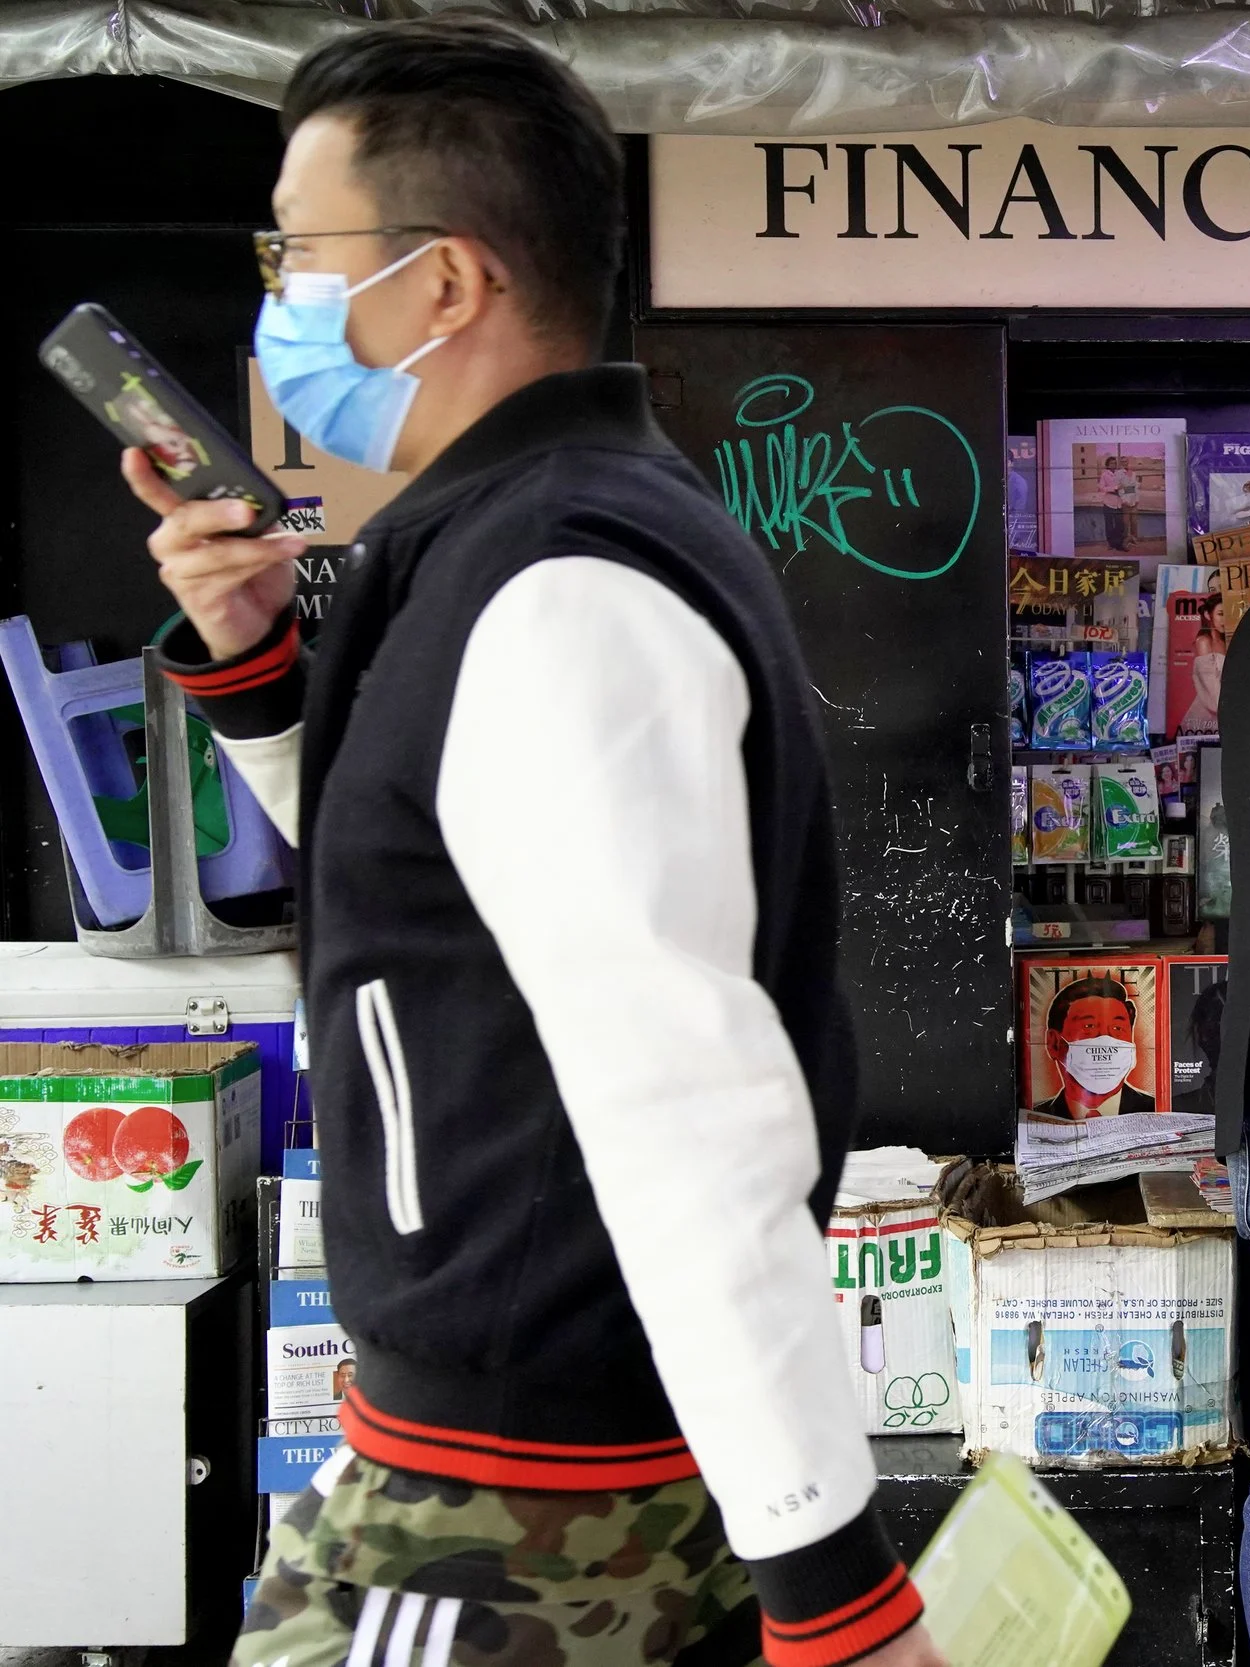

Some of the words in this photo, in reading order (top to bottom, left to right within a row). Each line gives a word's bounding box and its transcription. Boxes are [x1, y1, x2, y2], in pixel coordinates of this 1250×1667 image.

[1075, 424, 1162, 437] MANIFESTO
[1009, 566, 1126, 610] 今日家居
[1112, 807, 1158, 825] Extra
[1085, 1046, 1119, 1054] CHINA'S
[1194, 1060, 1203, 1068] of
[108, 1216, 194, 1236] 人间仙果
[881, 1284, 943, 1301] EXPORTADORA
[1026, 1298, 1058, 1307] BUSHEL
[1060, 1298, 1094, 1307] VOLUME
[1165, 1298, 1198, 1307] PRODUCE
[1206, 1298, 1223, 1307] SIZE
[995, 1310, 1019, 1319] 98816
[1022, 1310, 1035, 1319] WA
[1085, 1310, 1113, 1319] FRESH
[1116, 1310, 1152, 1319] CHELAN
[1155, 1310, 1167, 1319] BY
[1169, 1310, 1223, 1319] DISTRIBUTED
[282, 1340, 338, 1359] South
[1063, 1358, 1108, 1372] CHELAN
[1040, 1392, 1085, 1403] APPLES
[1089, 1392, 1180, 1402] WASHINGTON
[274, 1420, 313, 1435] CITY
[282, 1447, 325, 1464] THE
[766, 1482, 821, 1519] NSW
